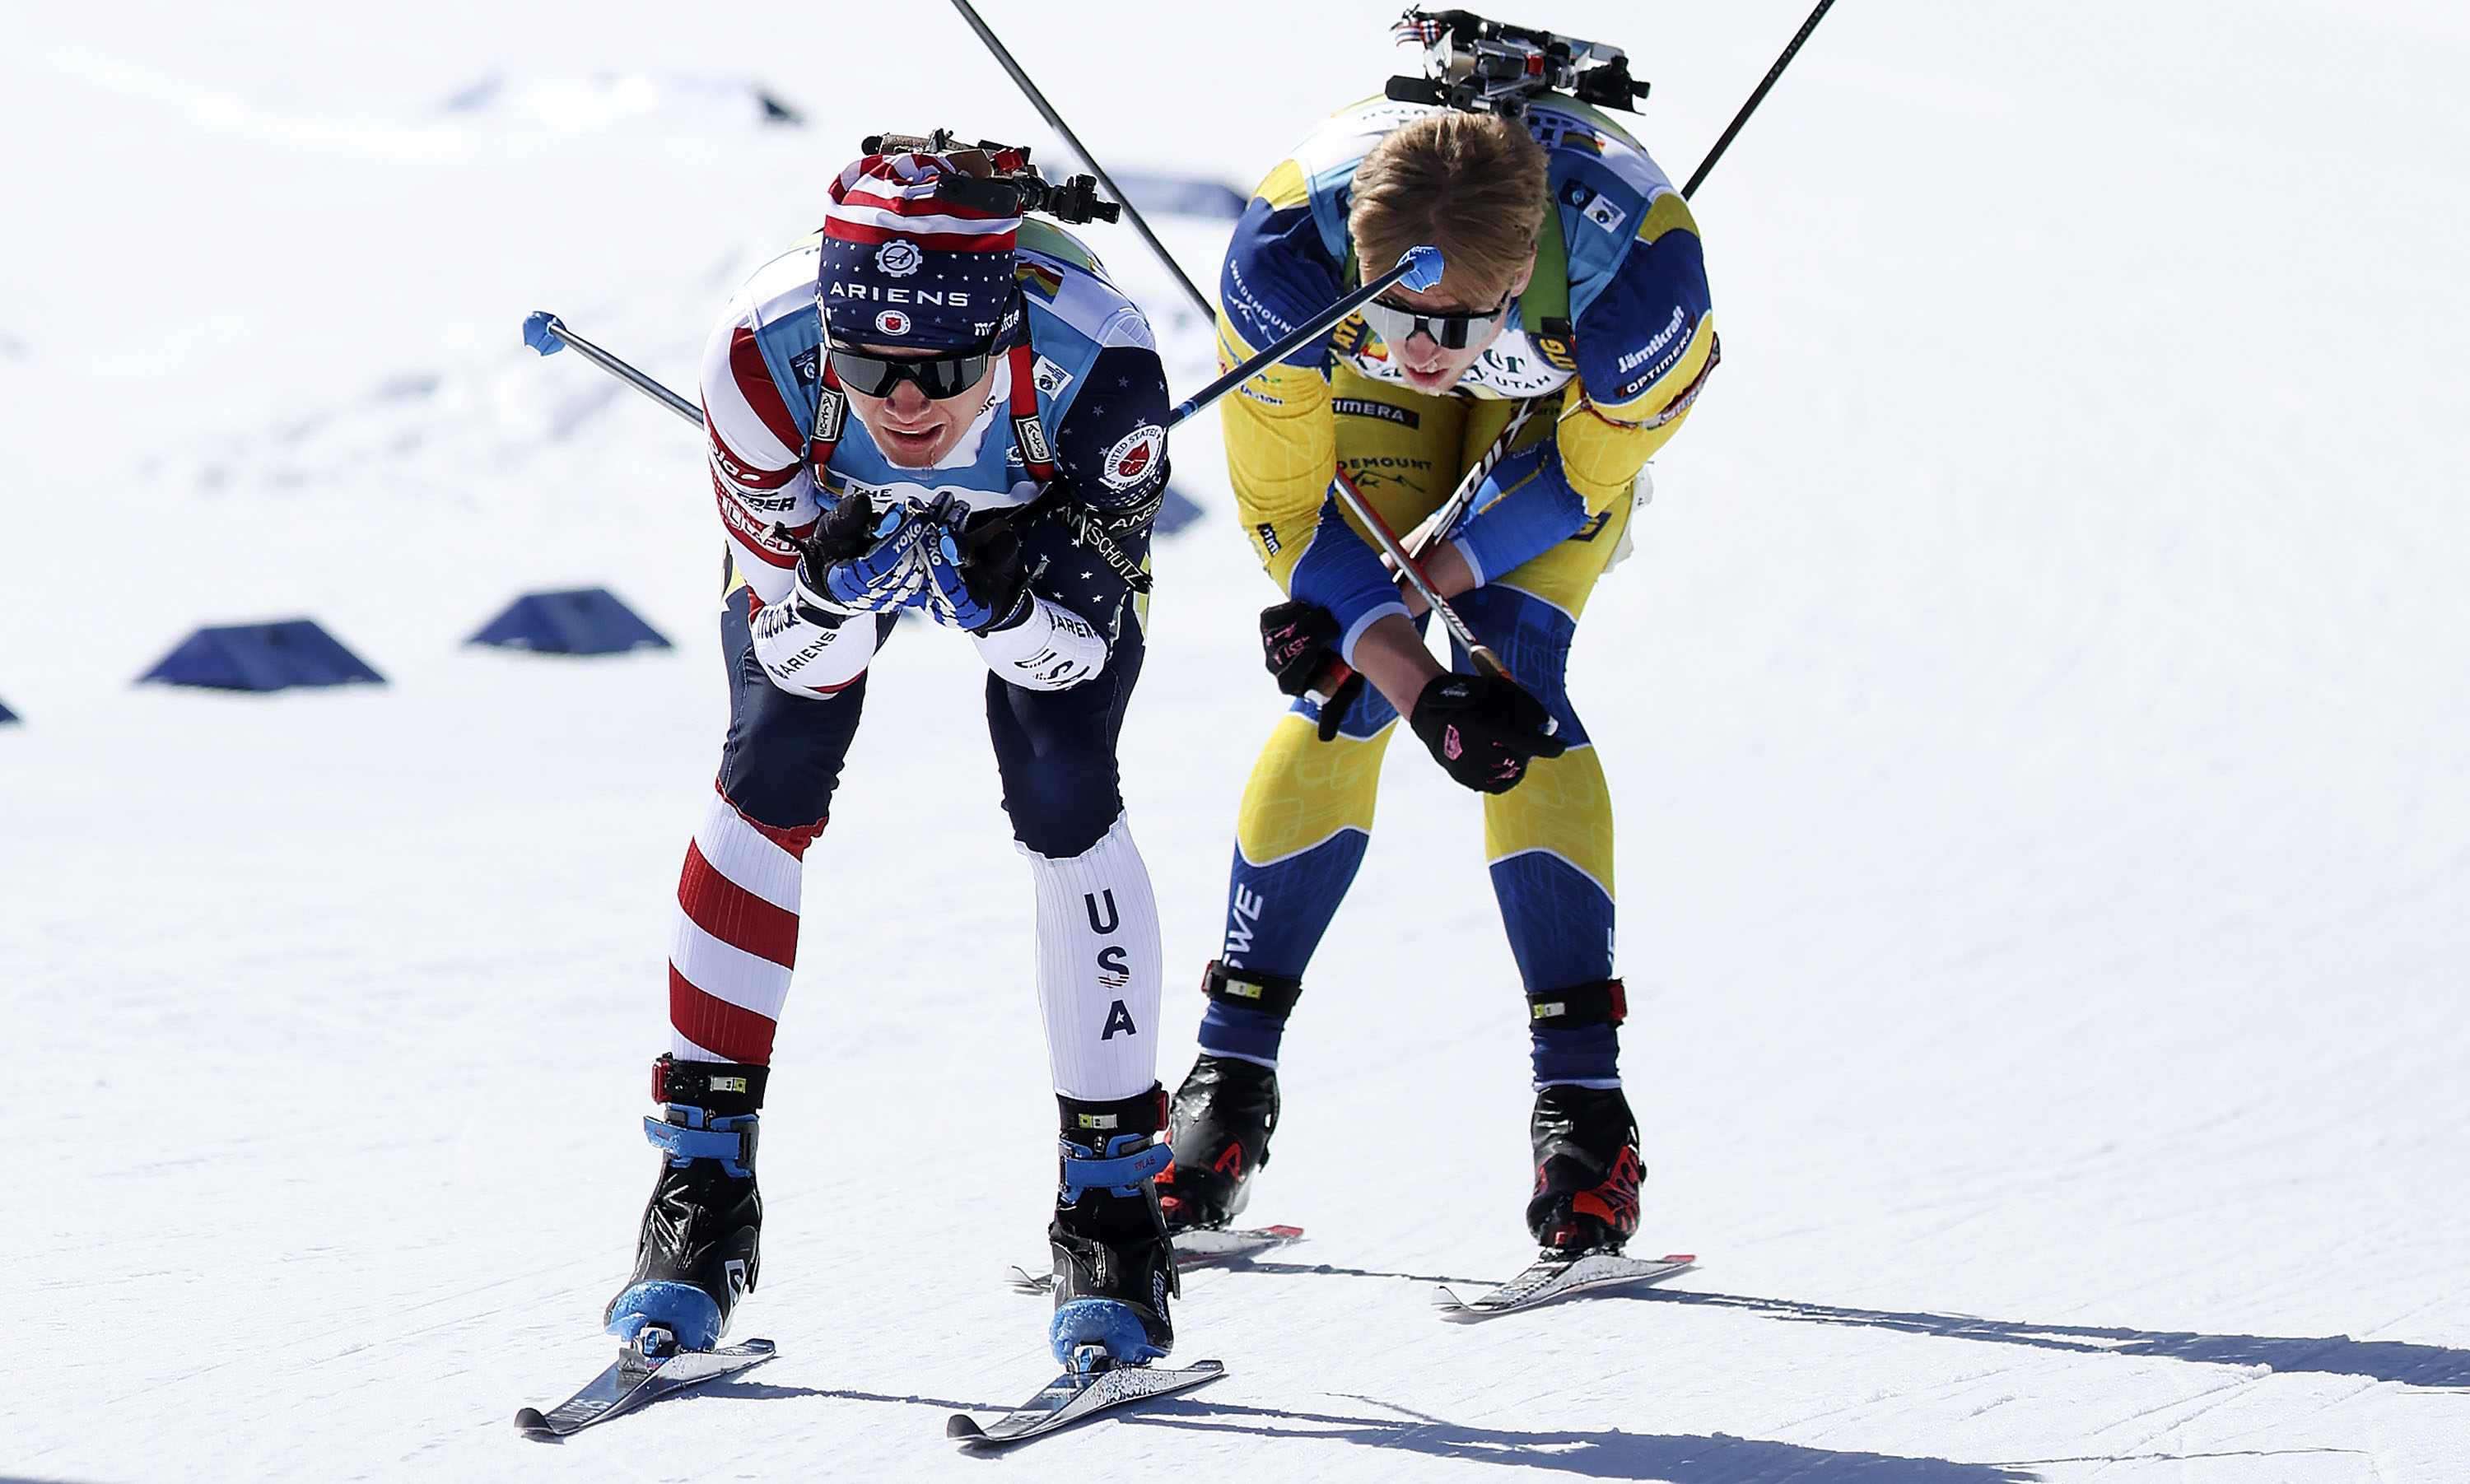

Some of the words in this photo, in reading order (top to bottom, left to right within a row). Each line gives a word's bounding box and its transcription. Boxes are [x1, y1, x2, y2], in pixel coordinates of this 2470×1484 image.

[830, 281, 968, 307] ARIENS
[1229, 258, 1297, 333] SWEDEMOUN
[1618, 305, 1685, 374] Jämtkraft
[1495, 375, 1550, 388] UTAH
[892, 523, 921, 554] TOKO
[779, 631, 837, 675] ARIENS
[1084, 888, 1137, 1041] USA
